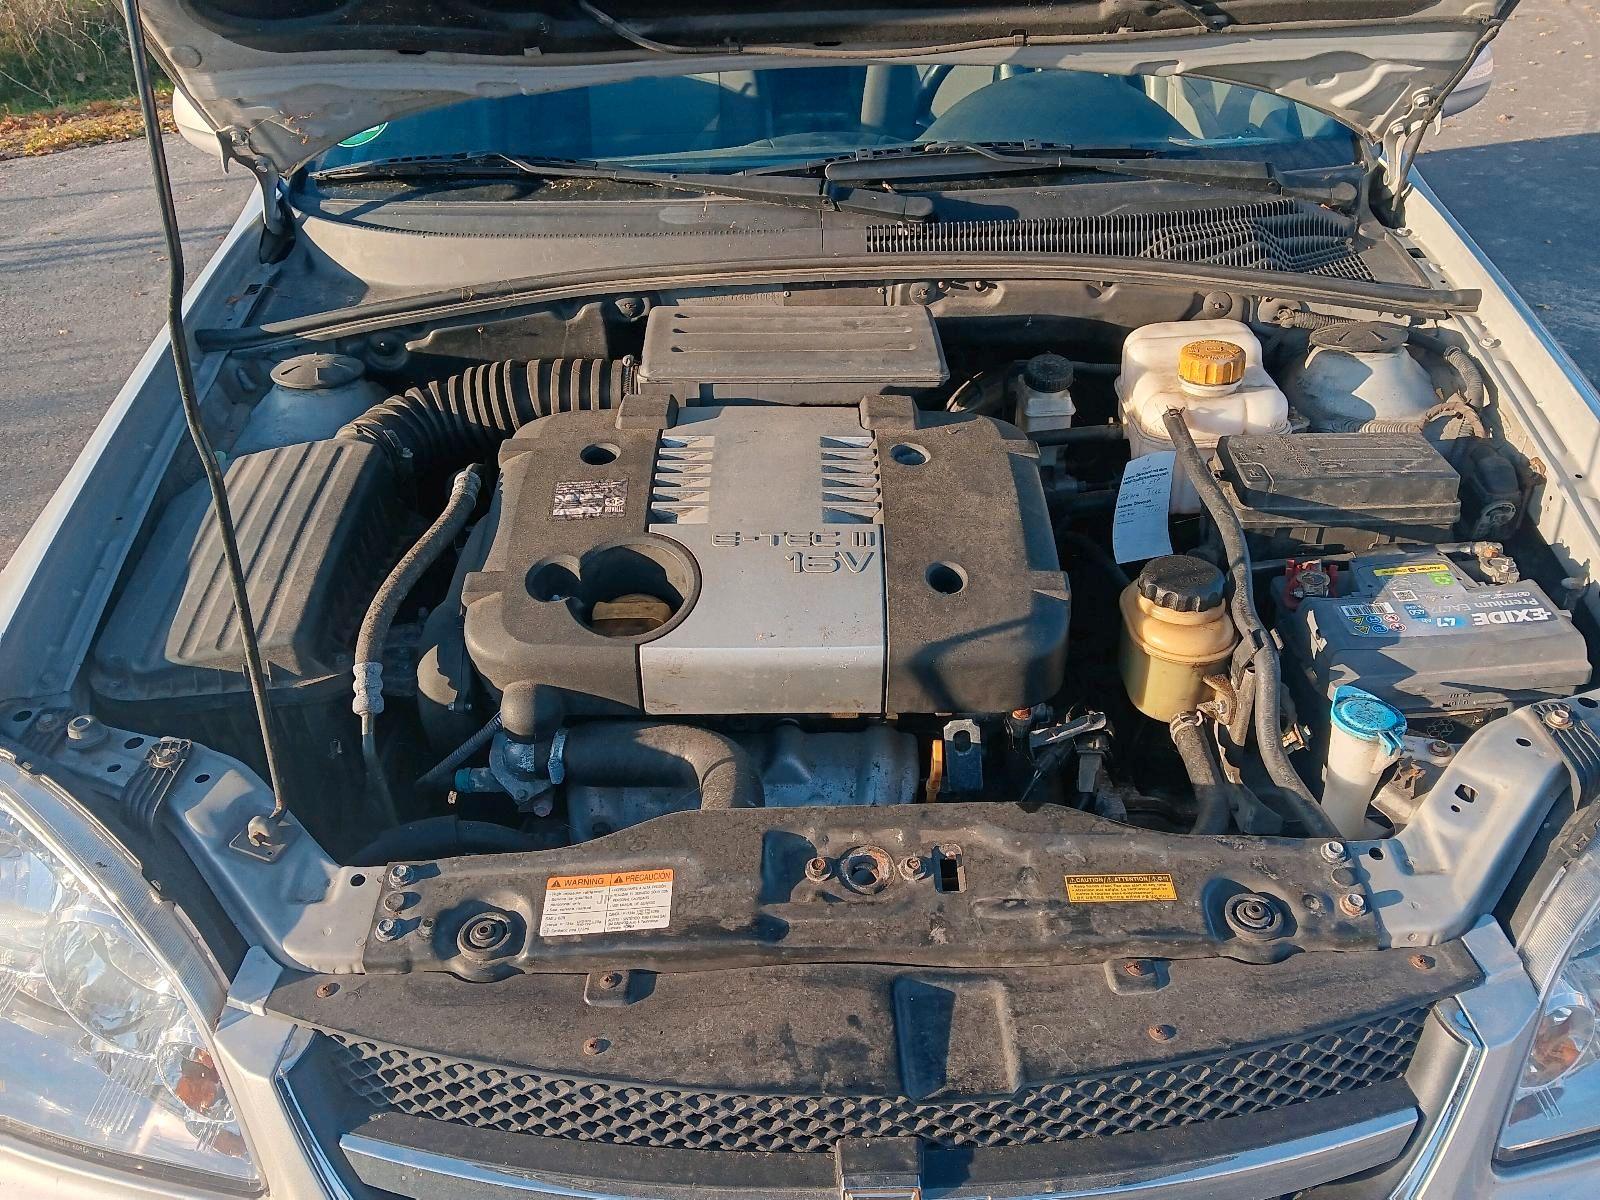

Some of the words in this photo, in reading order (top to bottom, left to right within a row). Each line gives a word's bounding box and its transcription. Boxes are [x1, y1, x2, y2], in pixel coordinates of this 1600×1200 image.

[711, 531, 841, 548] E-TEC
[784, 551, 875, 574] 16V
[1474, 597, 1540, 610] Premium
[1436, 617, 1456, 628] 47
[1472, 607, 1551, 626] EXIDE
[564, 877, 605, 887] WARNING
[625, 871, 671, 883] PRECAUCIÓN
